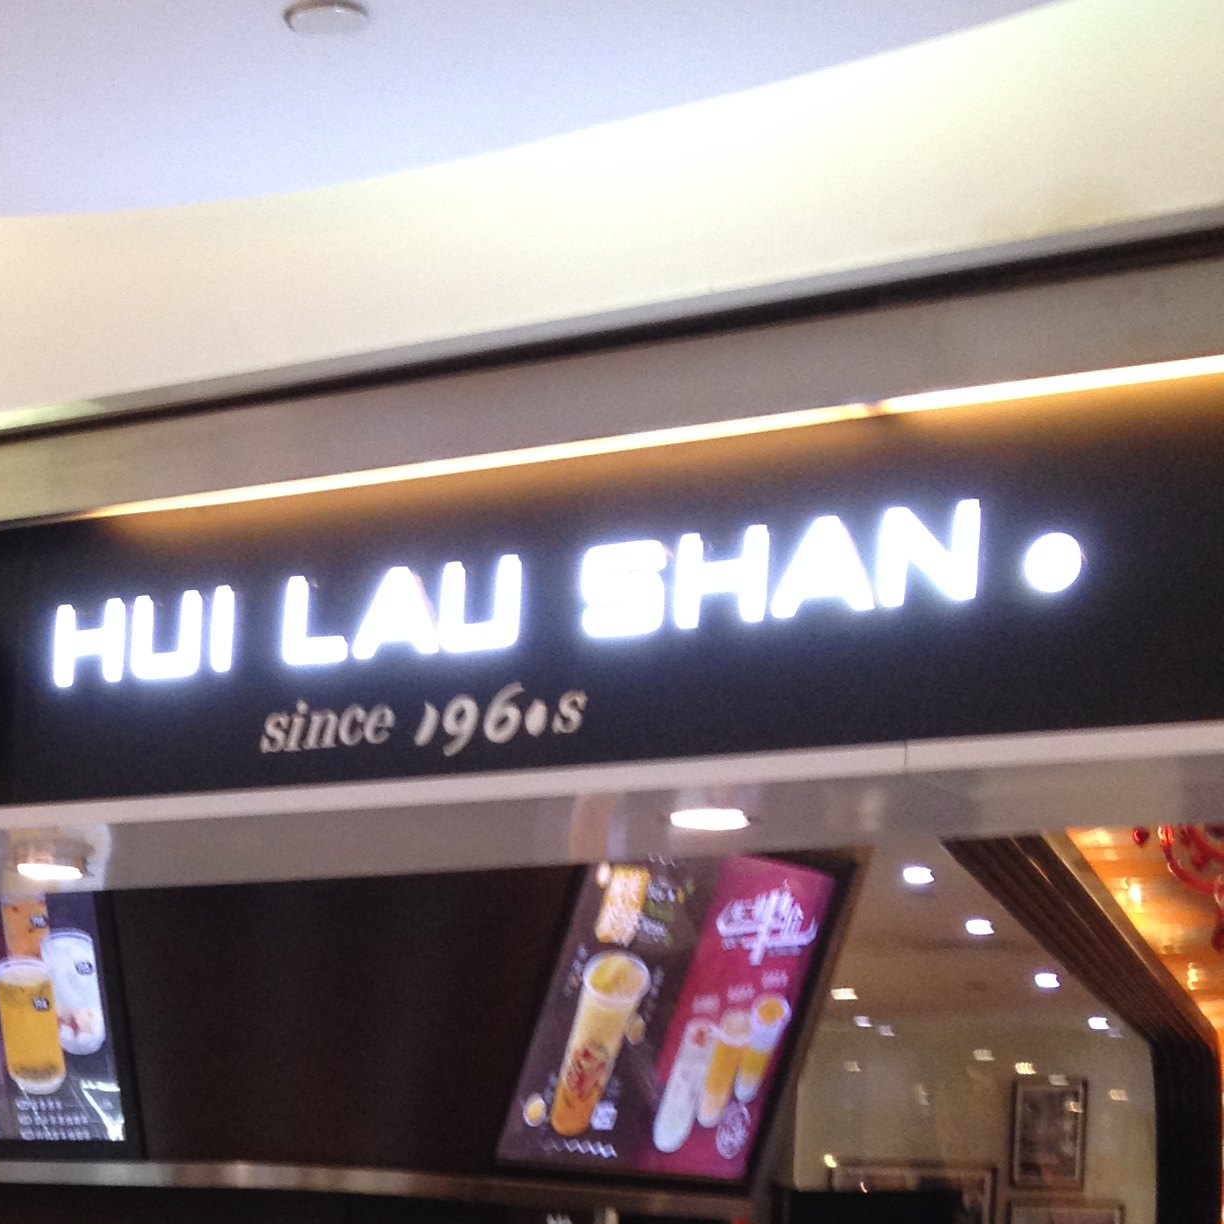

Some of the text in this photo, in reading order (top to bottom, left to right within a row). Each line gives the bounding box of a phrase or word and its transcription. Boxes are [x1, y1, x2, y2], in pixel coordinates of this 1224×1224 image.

[53, 498, 981, 688] HUI LAU SHAN
[259, 699, 396, 754] since
